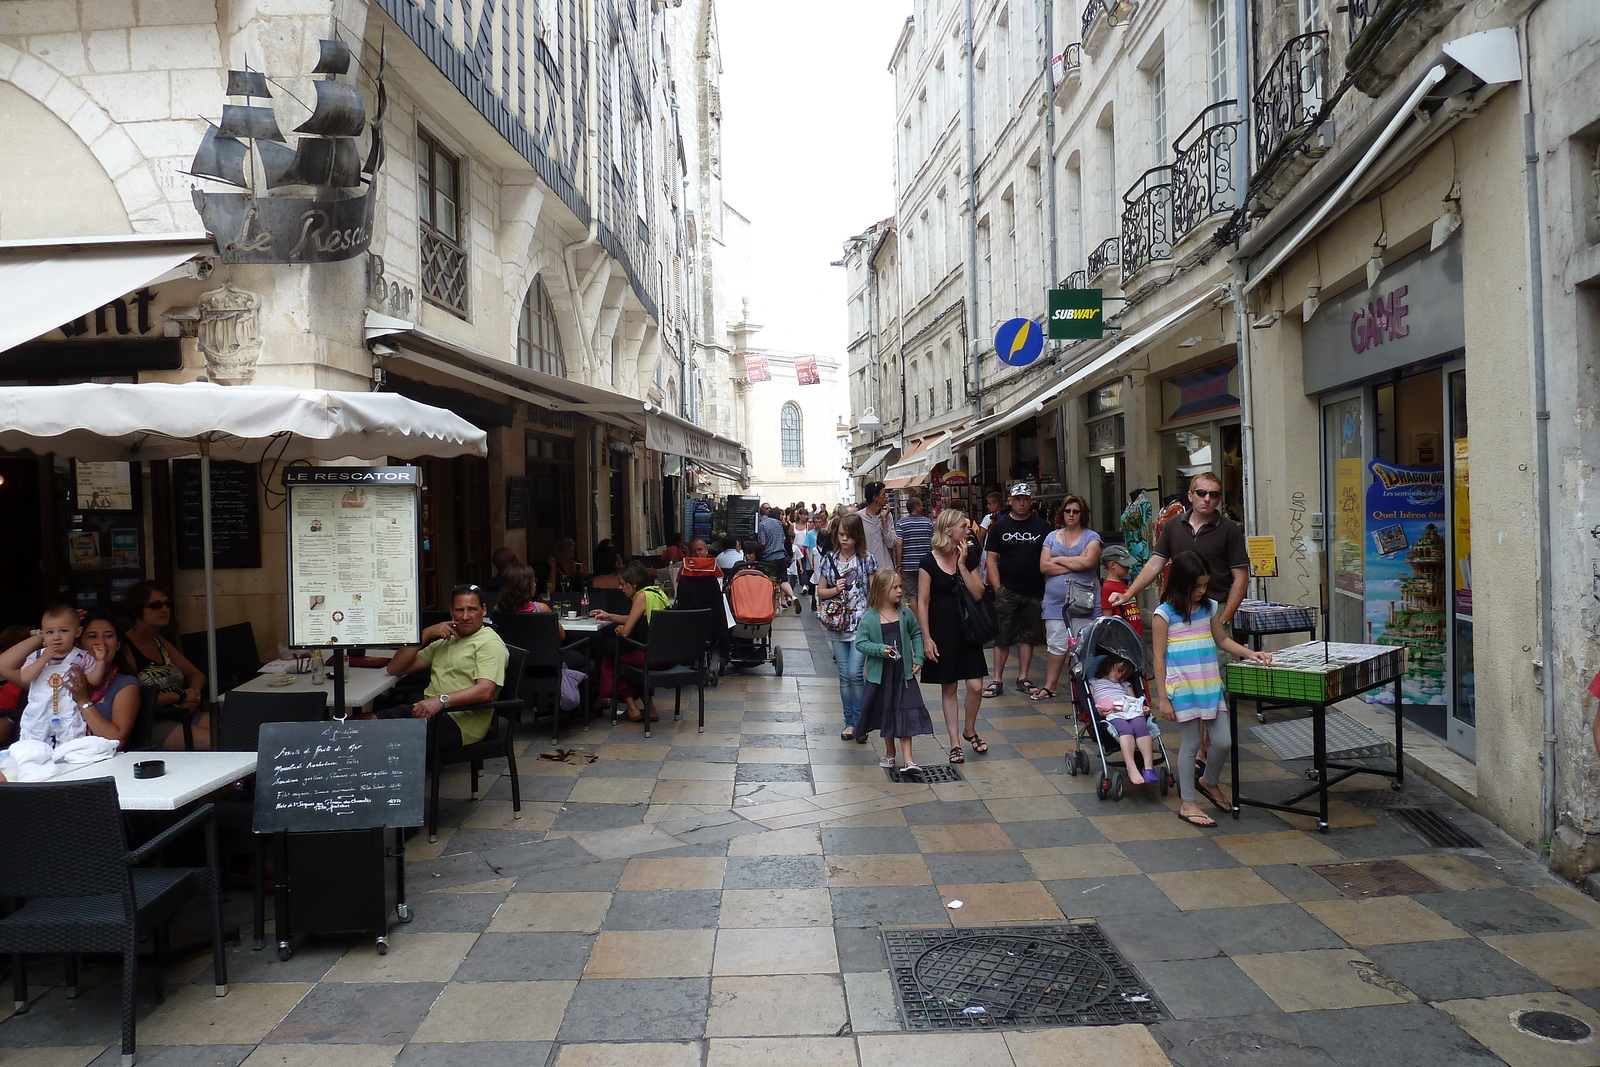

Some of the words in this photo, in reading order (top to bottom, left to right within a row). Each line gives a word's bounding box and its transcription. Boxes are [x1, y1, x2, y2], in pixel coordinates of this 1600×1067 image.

[227, 207, 271, 252] Le
[365, 250, 414, 316] Bar
[1052, 308, 1101, 320] SUBWAY
[1351, 285, 1409, 354] GAME
[287, 472, 308, 481] LE
[315, 472, 410, 480] RESCATOR
[1372, 463, 1430, 490] DRAGON
[1373, 511, 1397, 521] Quel
[1400, 510, 1427, 519] héros
